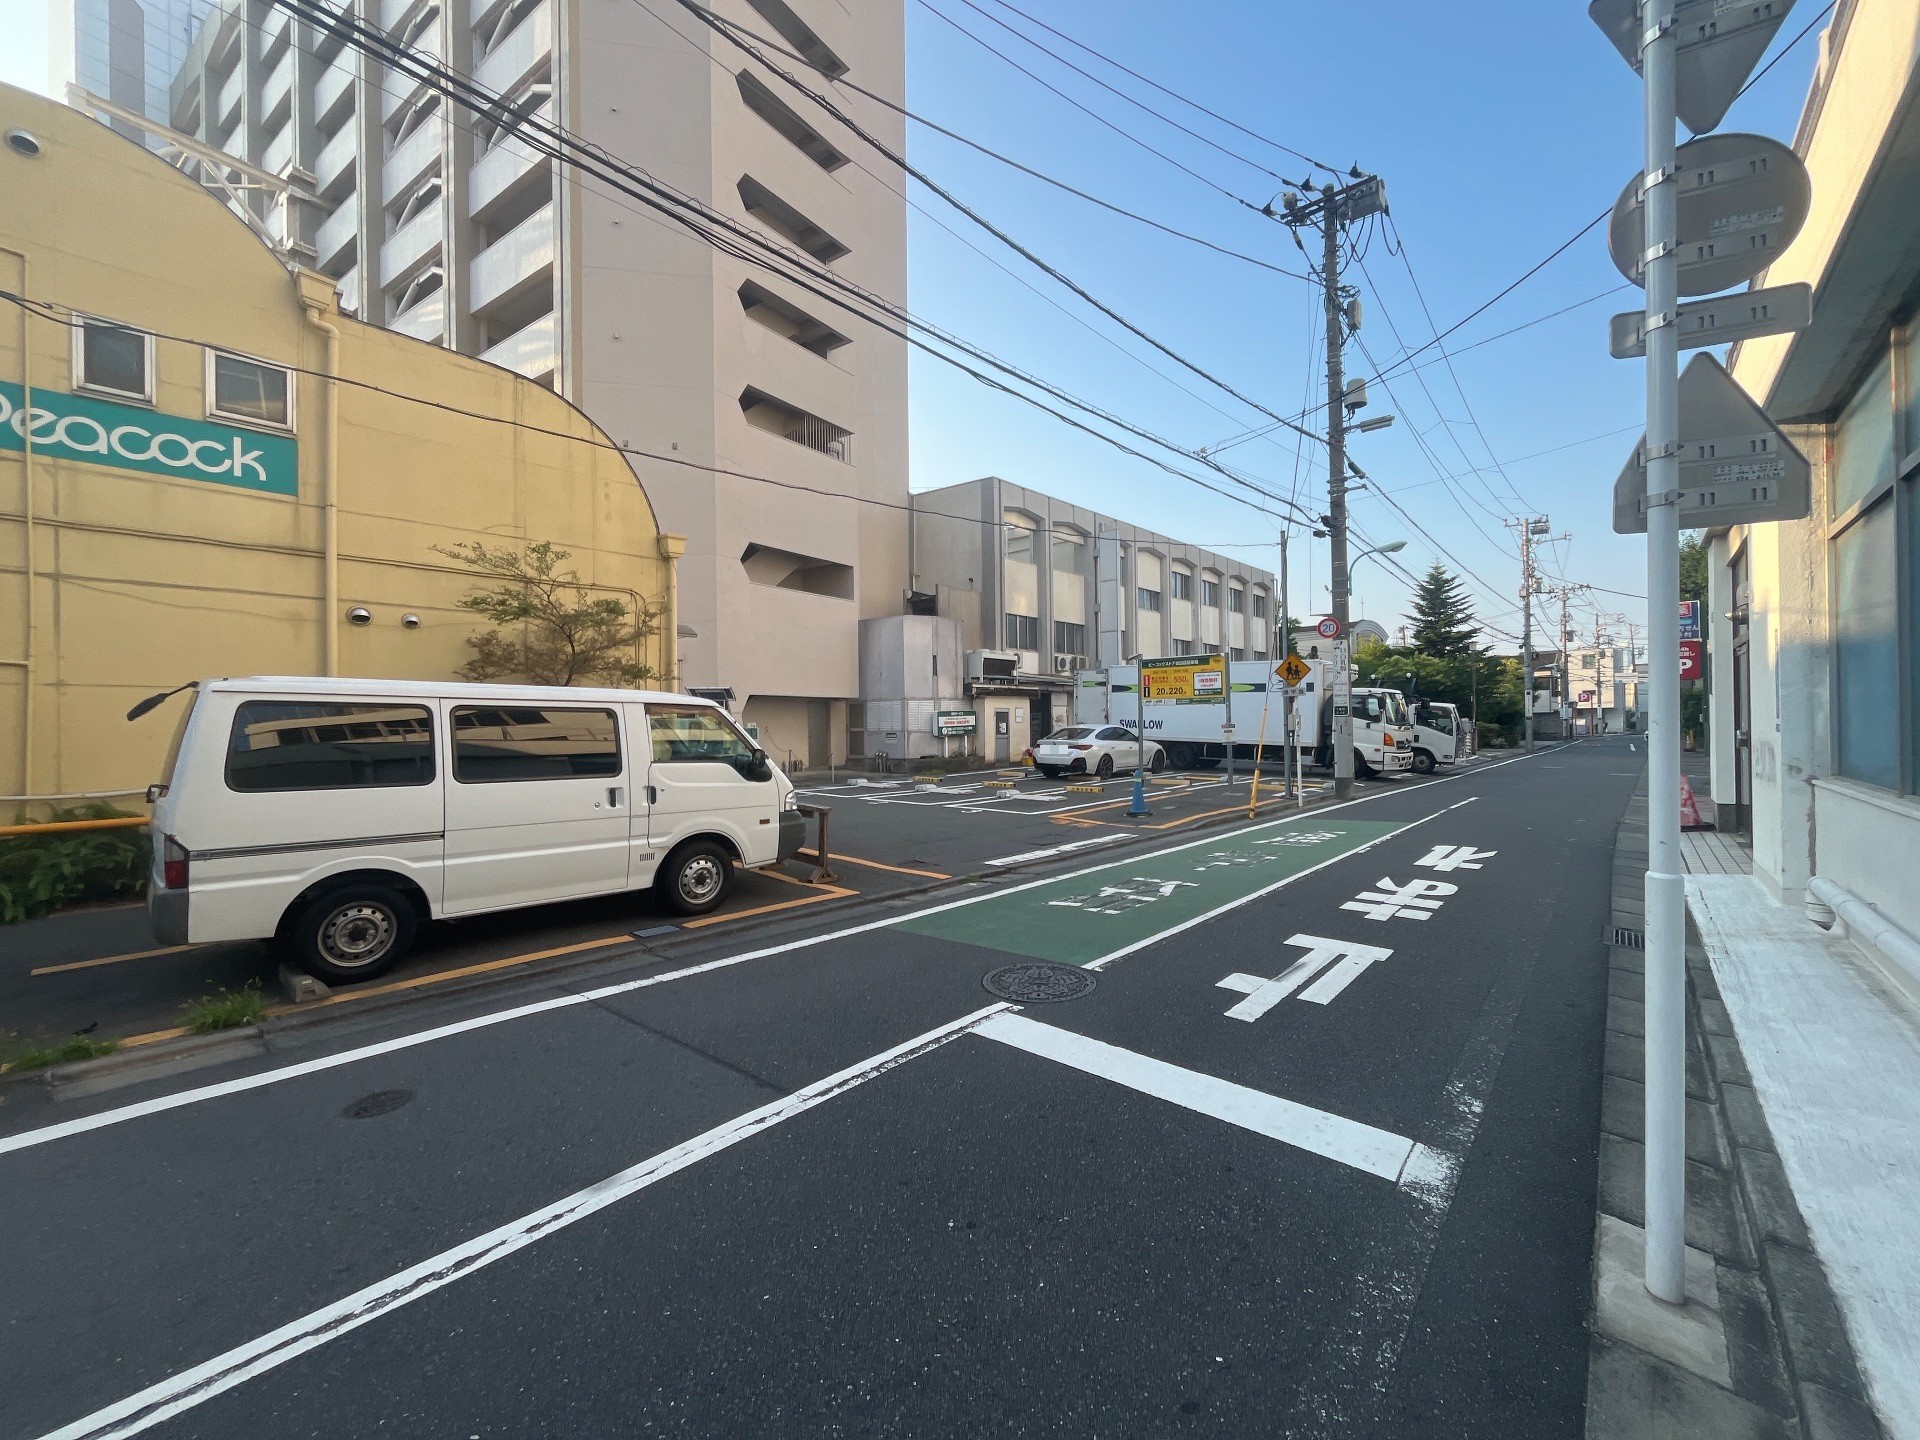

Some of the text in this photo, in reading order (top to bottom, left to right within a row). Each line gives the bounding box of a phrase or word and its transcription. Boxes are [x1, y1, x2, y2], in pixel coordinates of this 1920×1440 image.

[1322, 623, 1335, 633] 20
[1679, 658, 1693, 675] P
[1581, 693, 1588, 701] P
